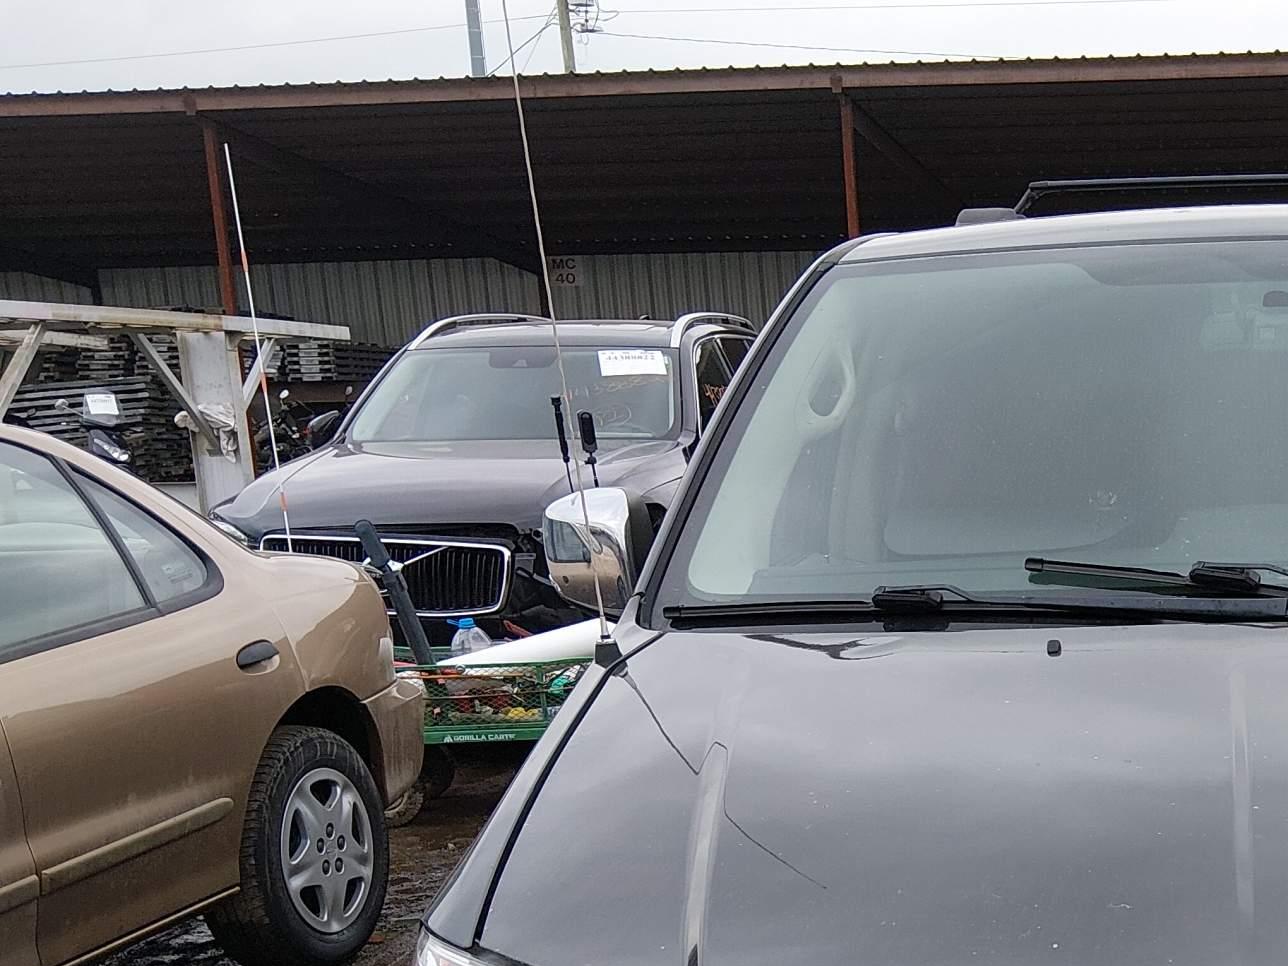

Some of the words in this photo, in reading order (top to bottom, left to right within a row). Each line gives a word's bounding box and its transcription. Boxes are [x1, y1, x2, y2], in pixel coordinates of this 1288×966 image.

[551, 258, 577, 270] MC
[556, 272, 576, 284] 40
[453, 733, 487, 742] GORILLA
